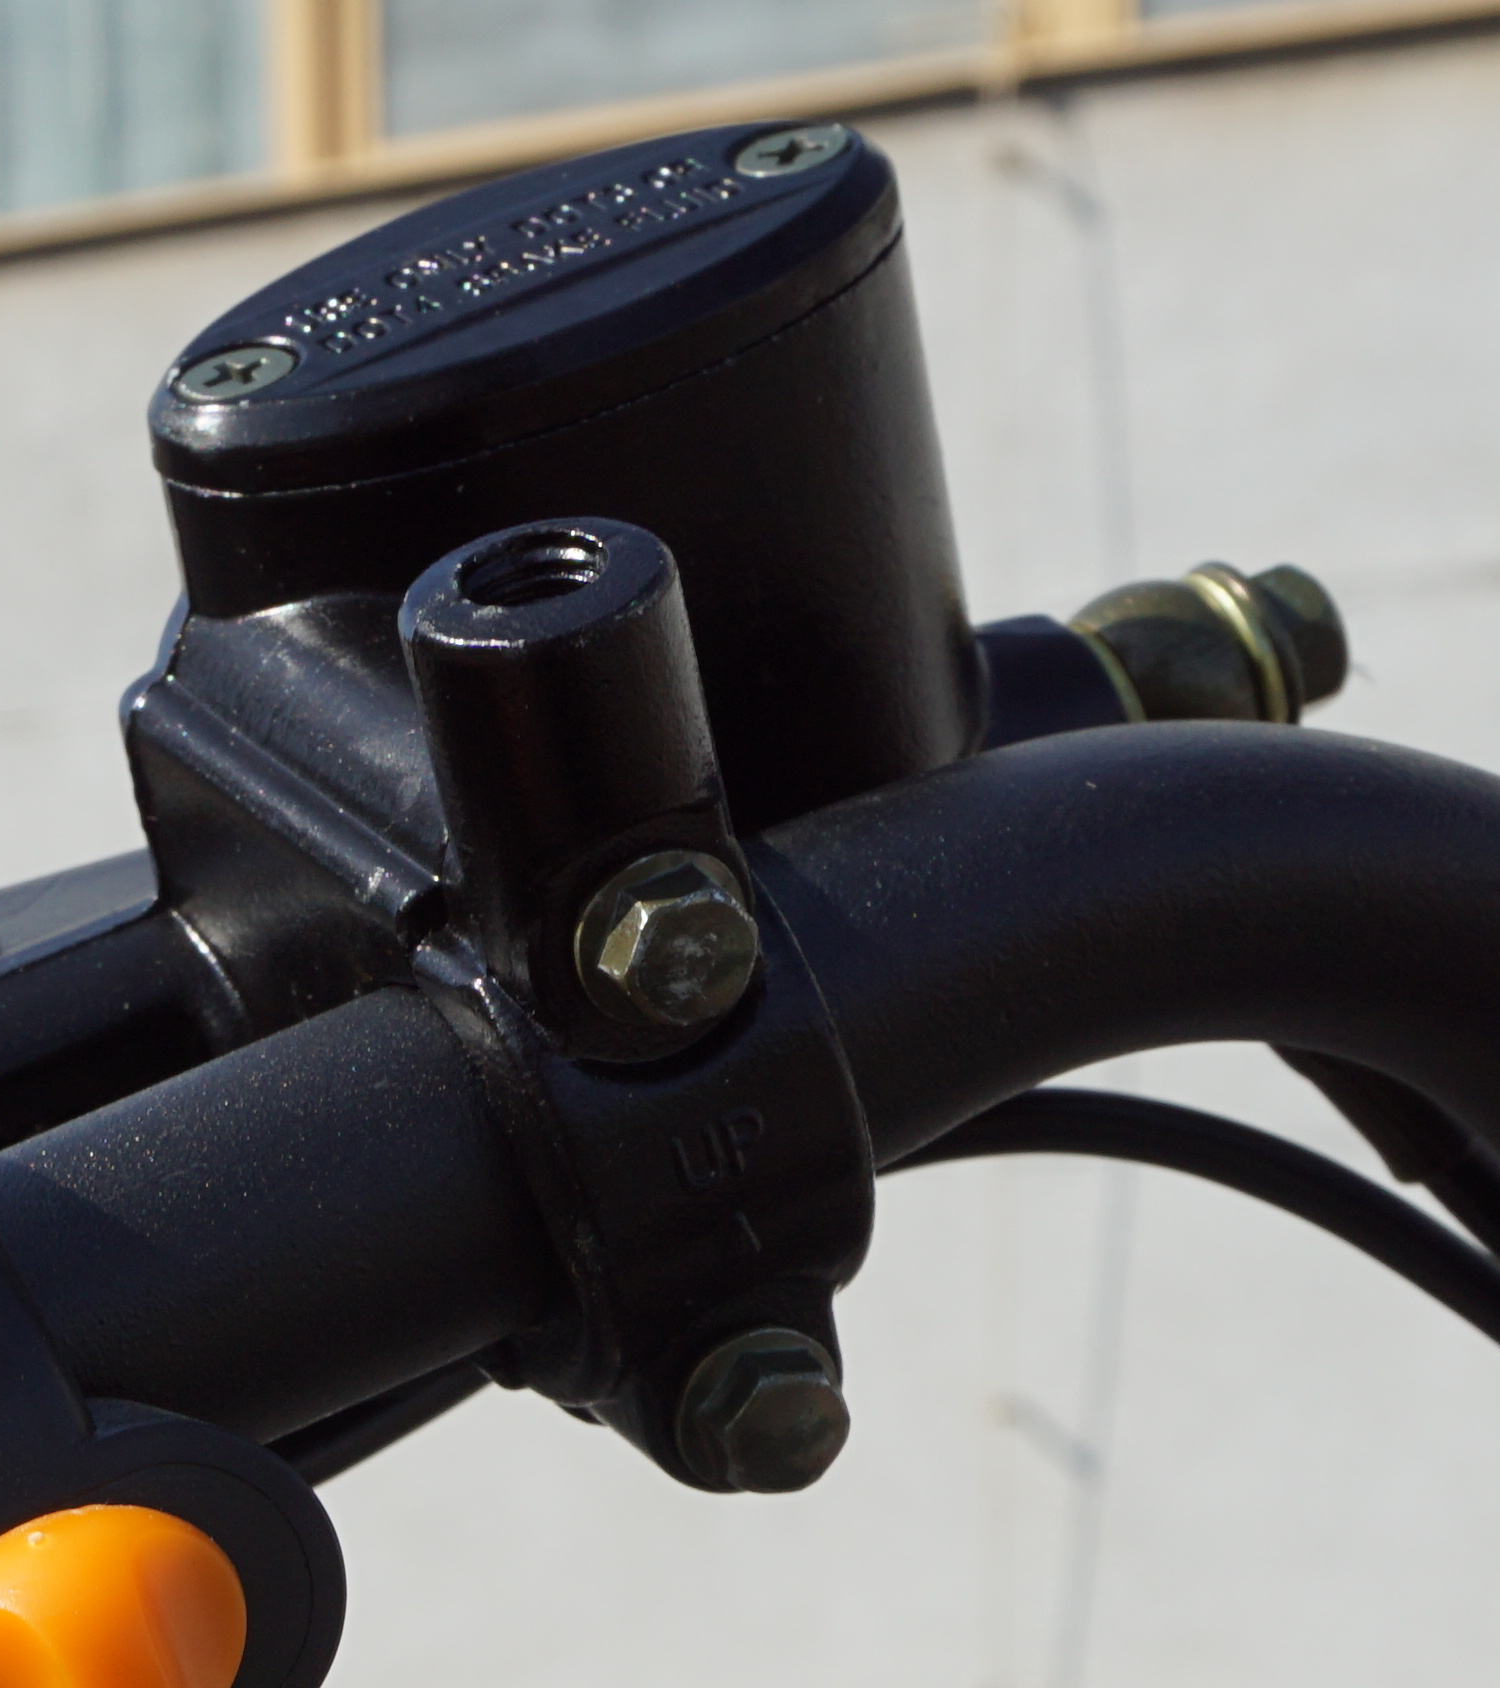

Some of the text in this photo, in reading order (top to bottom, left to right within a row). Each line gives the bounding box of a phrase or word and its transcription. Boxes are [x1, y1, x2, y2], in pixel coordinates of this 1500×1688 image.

[284, 286, 375, 334] USE
[384, 234, 497, 290] ONLY
[639, 156, 711, 190] OR
[456, 227, 612, 297] BRAKE
[613, 177, 746, 233] FLUID
[669, 1105, 767, 1197] UP
